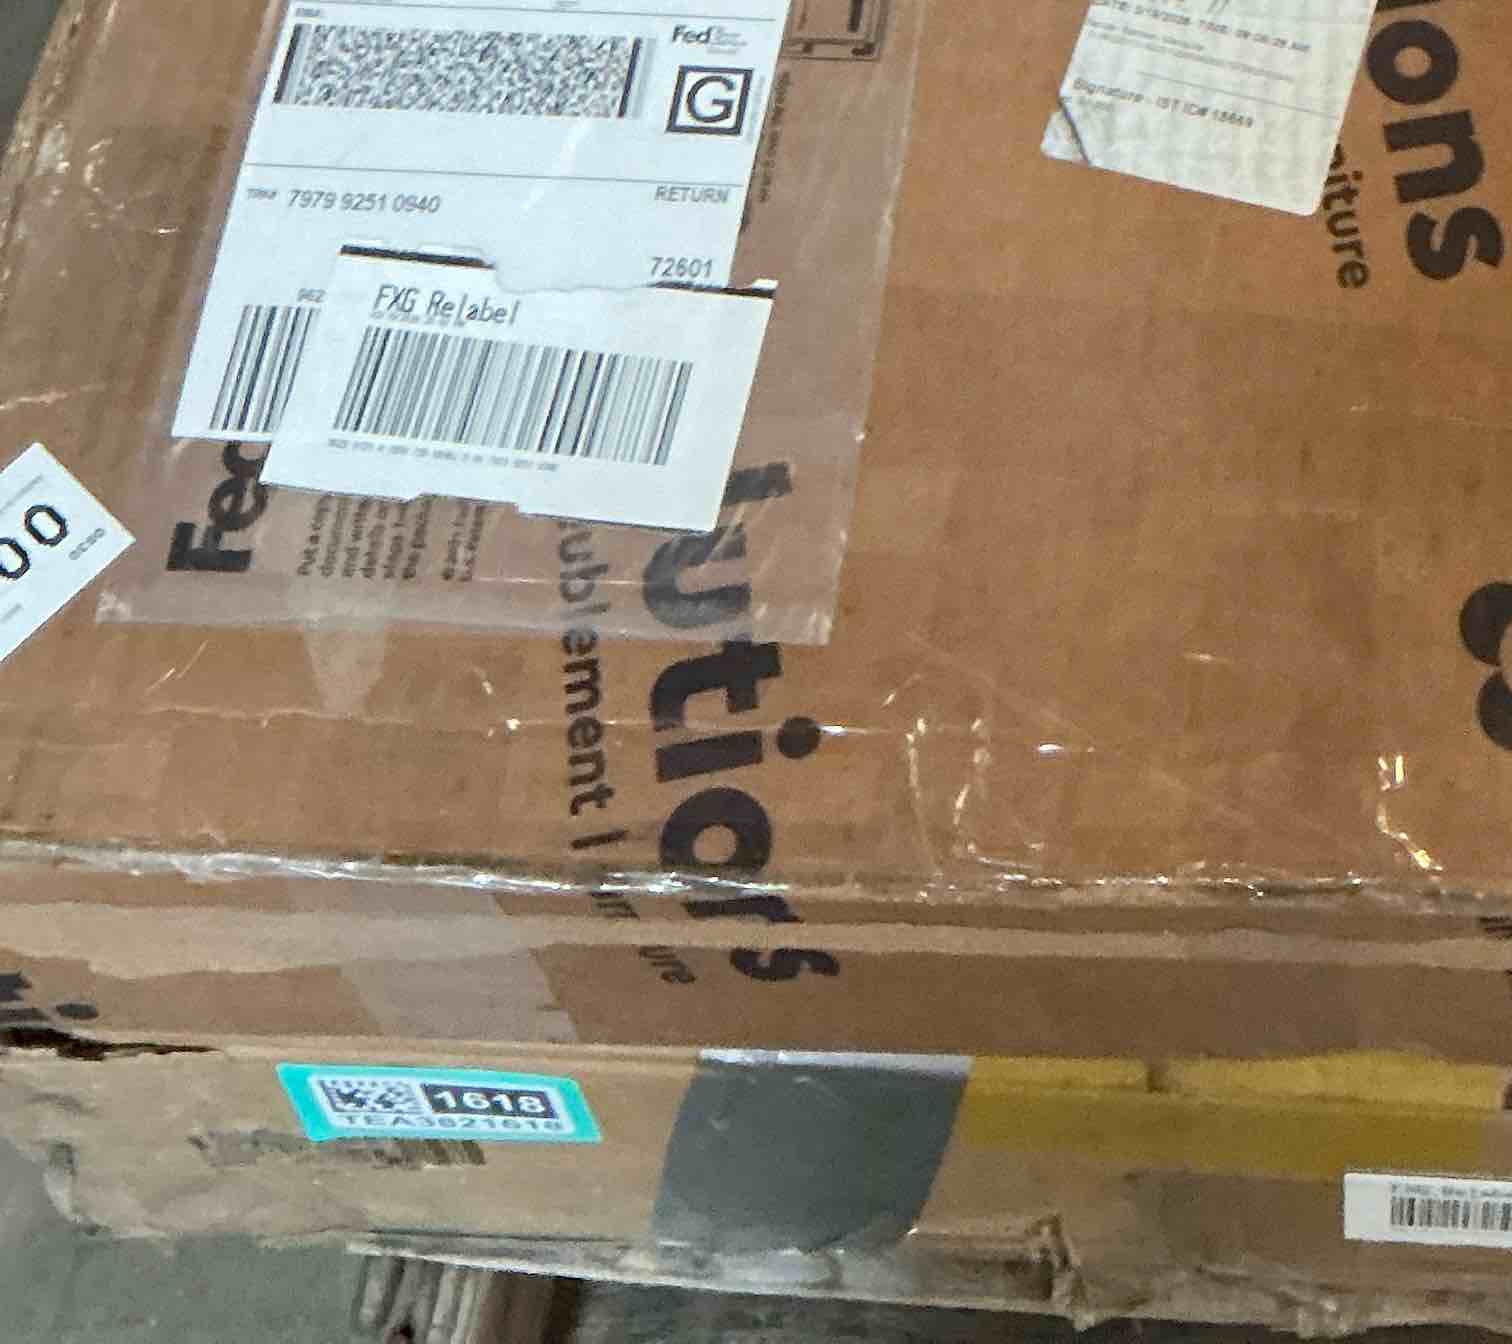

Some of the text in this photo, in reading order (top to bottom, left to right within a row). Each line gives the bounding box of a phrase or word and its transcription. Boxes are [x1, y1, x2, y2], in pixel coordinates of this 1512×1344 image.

[686, 75, 737, 124] G
[1072, 77, 1144, 104] Signature
[287, 188, 336, 210] 7979
[340, 193, 388, 212] 9251
[392, 194, 442, 214] 0940
[654, 184, 731, 204] RETURN
[650, 256, 714, 278] 72601
[372, 283, 521, 326] FXG Relabel
[429, 1087, 548, 1116] 1618
